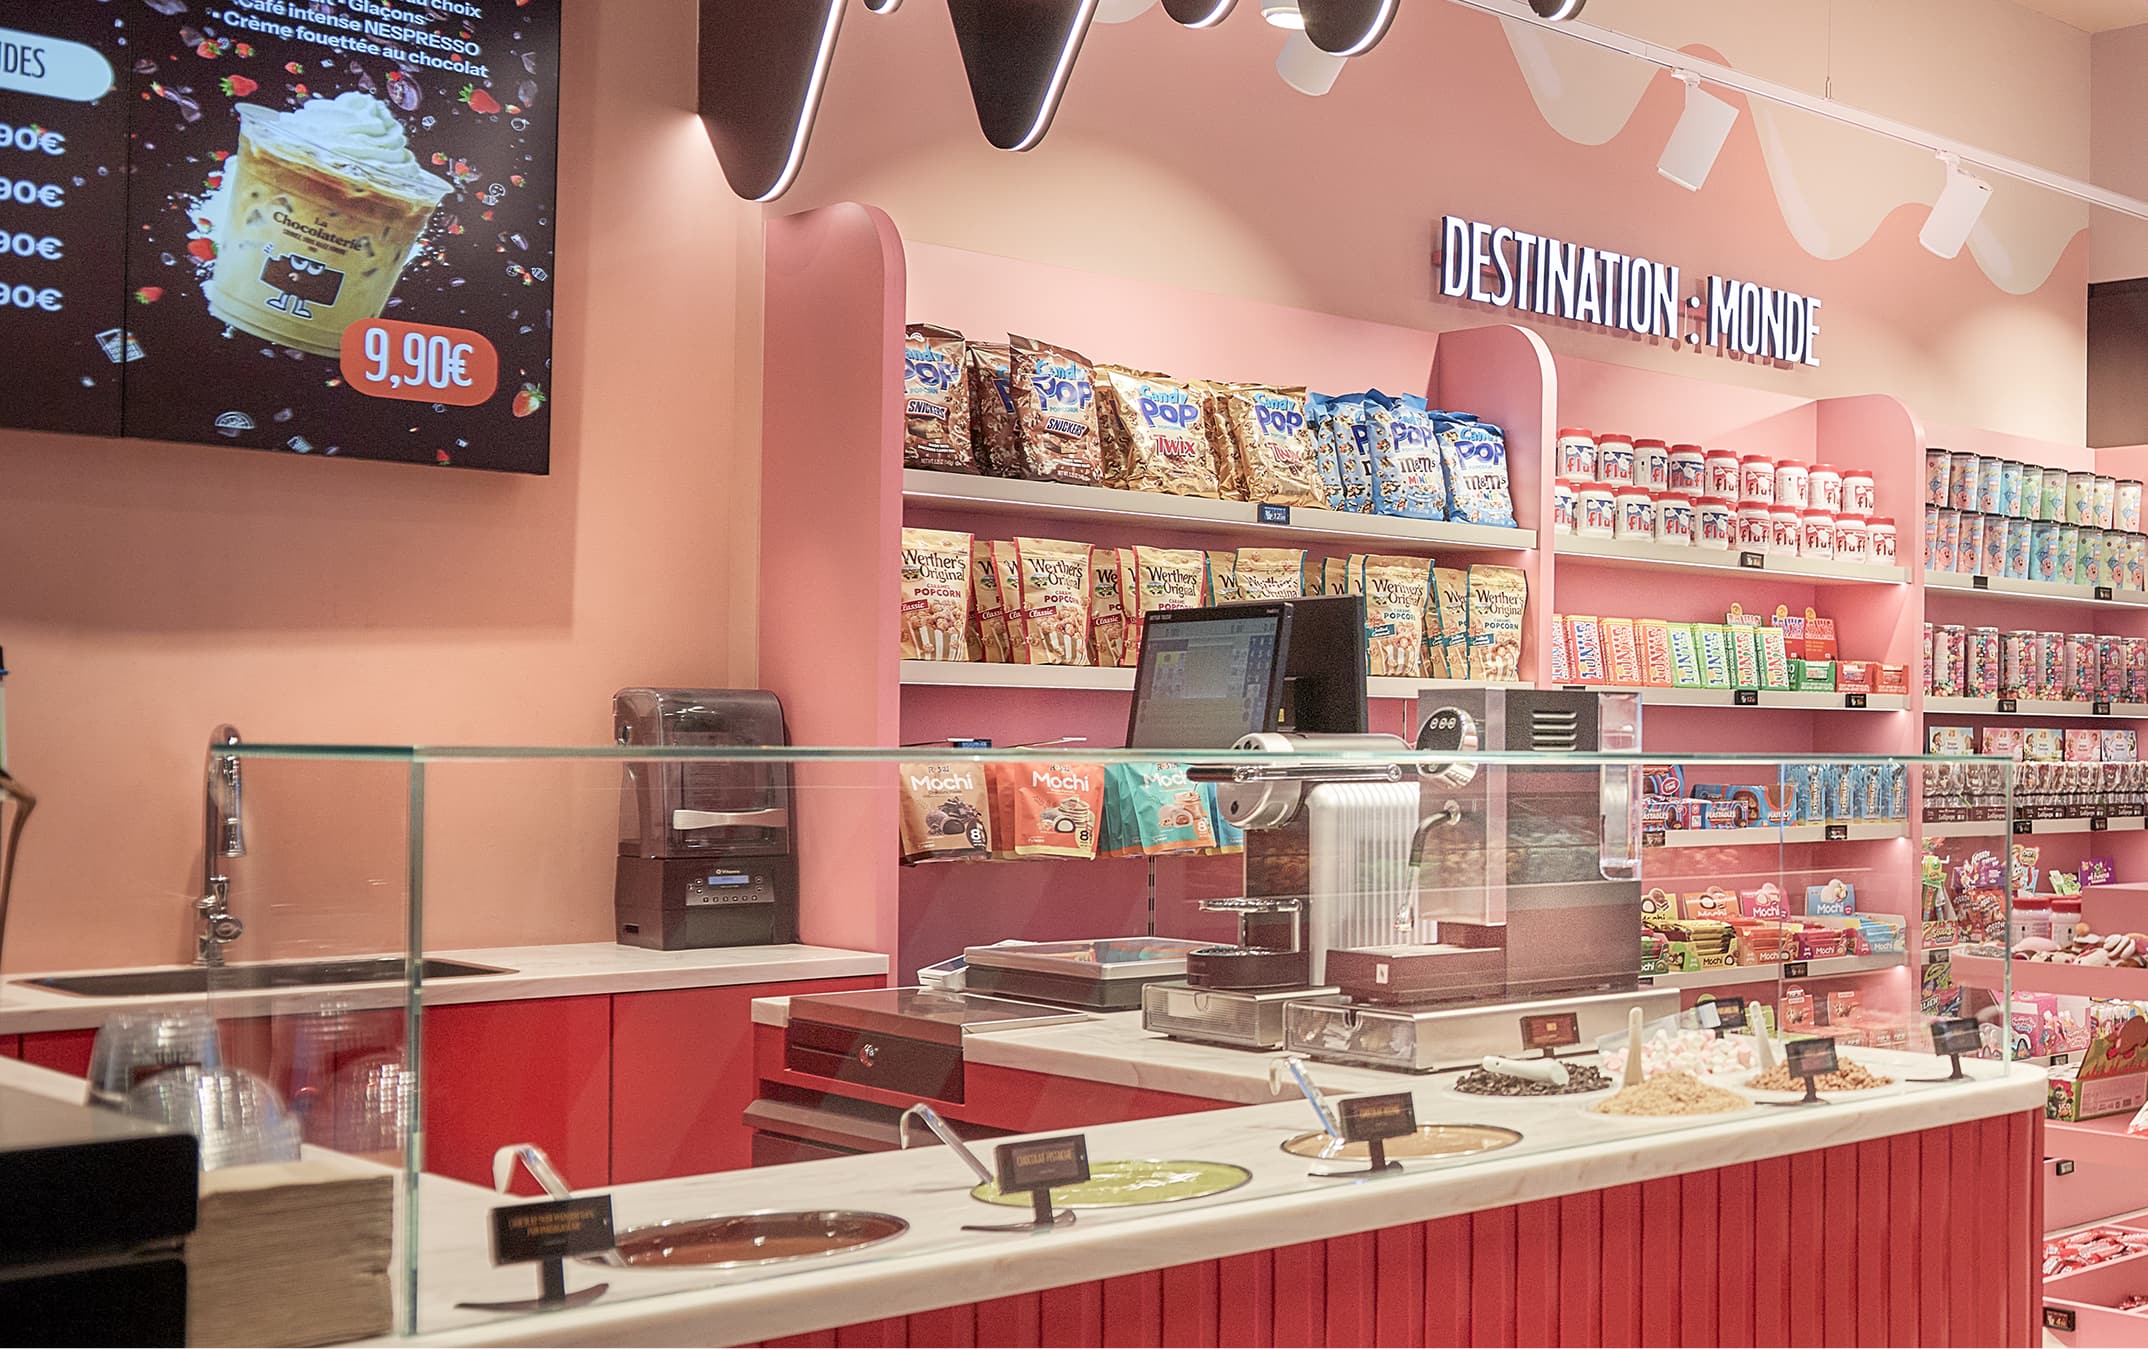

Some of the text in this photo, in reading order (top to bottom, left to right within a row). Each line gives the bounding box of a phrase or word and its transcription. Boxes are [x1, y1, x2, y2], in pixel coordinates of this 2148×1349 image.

[348, 0, 428, 25] Glaçons
[431, 0, 482, 20] choix
[238, 0, 480, 56] Café intense NESPRESSO
[223, 10, 489, 78] Crème fouettée au chocolat
[0, 43, 46, 79] DES
[273, 211, 362, 251] Chocolaterie
[1440, 215, 1679, 339] DESTINATION
[1705, 274, 1821, 367] MONDE
[364, 327, 474, 389] 9,90€
[904, 344, 944, 362] andy
[1140, 384, 1188, 405] Candy
[908, 400, 946, 419] SNICKERS
[1046, 418, 1086, 437] SNICKERS
[1567, 456, 1596, 473] fluf
[1605, 463, 1633, 479] fluf
[1715, 477, 1736, 491] flu
[1748, 482, 1773, 495] fluf
[1857, 496, 1874, 509] flu
[1665, 519, 1688, 535] flu
[1704, 524, 1726, 540] flu
[1775, 532, 1794, 546] flu
[1807, 535, 1832, 549] fluf
[901, 548, 967, 570] Werther's
[919, 564, 966, 584] Original
[1027, 558, 1083, 578] Werther's
[1146, 566, 1198, 585] Werther's
[914, 588, 961, 599] POPCORN
[1371, 579, 1424, 597] Werther's
[1475, 588, 1525, 605] Werther's
[1029, 608, 1054, 619] Classic
[1095, 616, 1120, 626] Classic
[1484, 622, 1519, 631] POPCORN
[910, 773, 974, 792] Mochi
[1032, 770, 1090, 792] Mochi
[970, 828, 981, 841] 8
[1079, 829, 1089, 841] 8
[1752, 906, 1780, 918] Mochi
[1817, 902, 1844, 915] Mochi
[1815, 945, 1836, 955] Mochi
[1874, 941, 1893, 951] Mochi
[1703, 956, 1723, 967] Mochi
